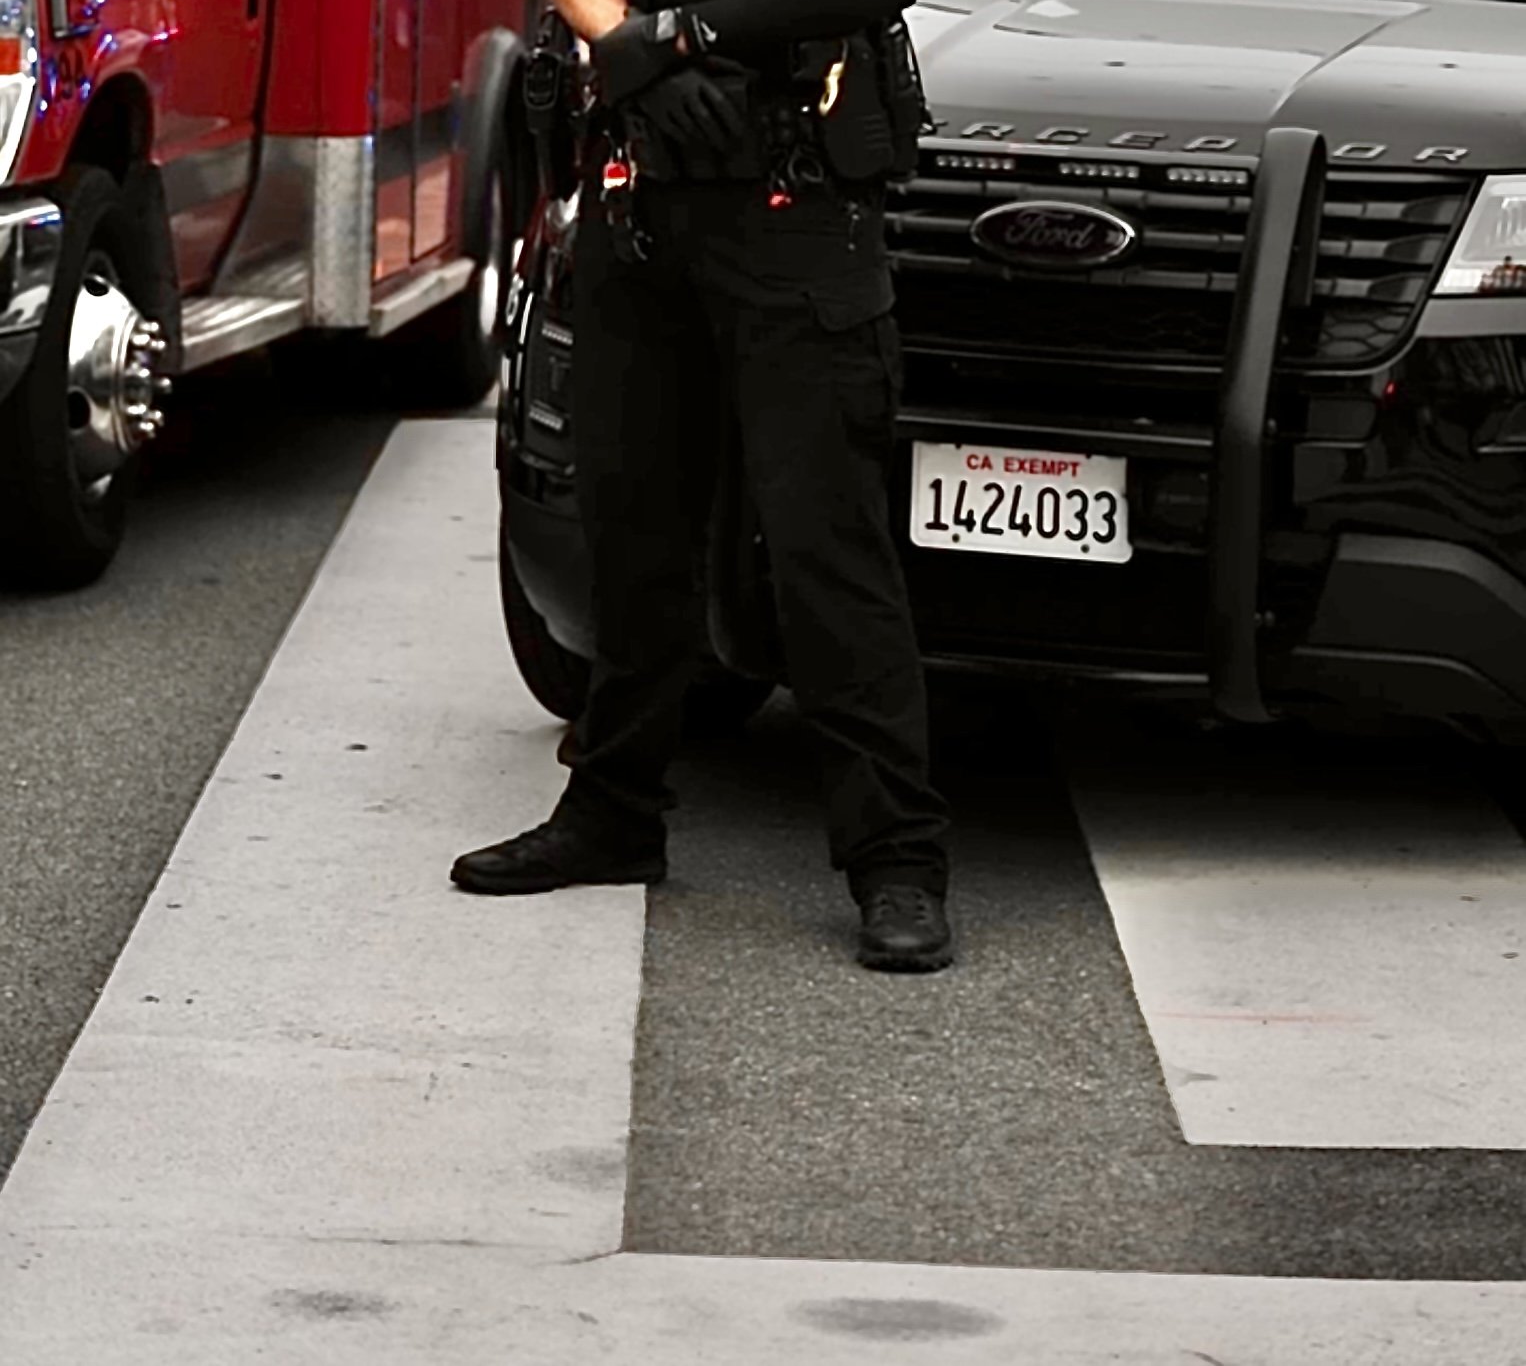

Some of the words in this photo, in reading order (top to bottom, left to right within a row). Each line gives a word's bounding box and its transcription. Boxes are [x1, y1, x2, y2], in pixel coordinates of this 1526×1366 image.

[931, 119, 1470, 162] RCEPOR
[1004, 209, 1096, 249] Ford
[966, 454, 993, 471] CA
[1004, 456, 1081, 477] EXEMPT
[925, 478, 1117, 543] 1424033
